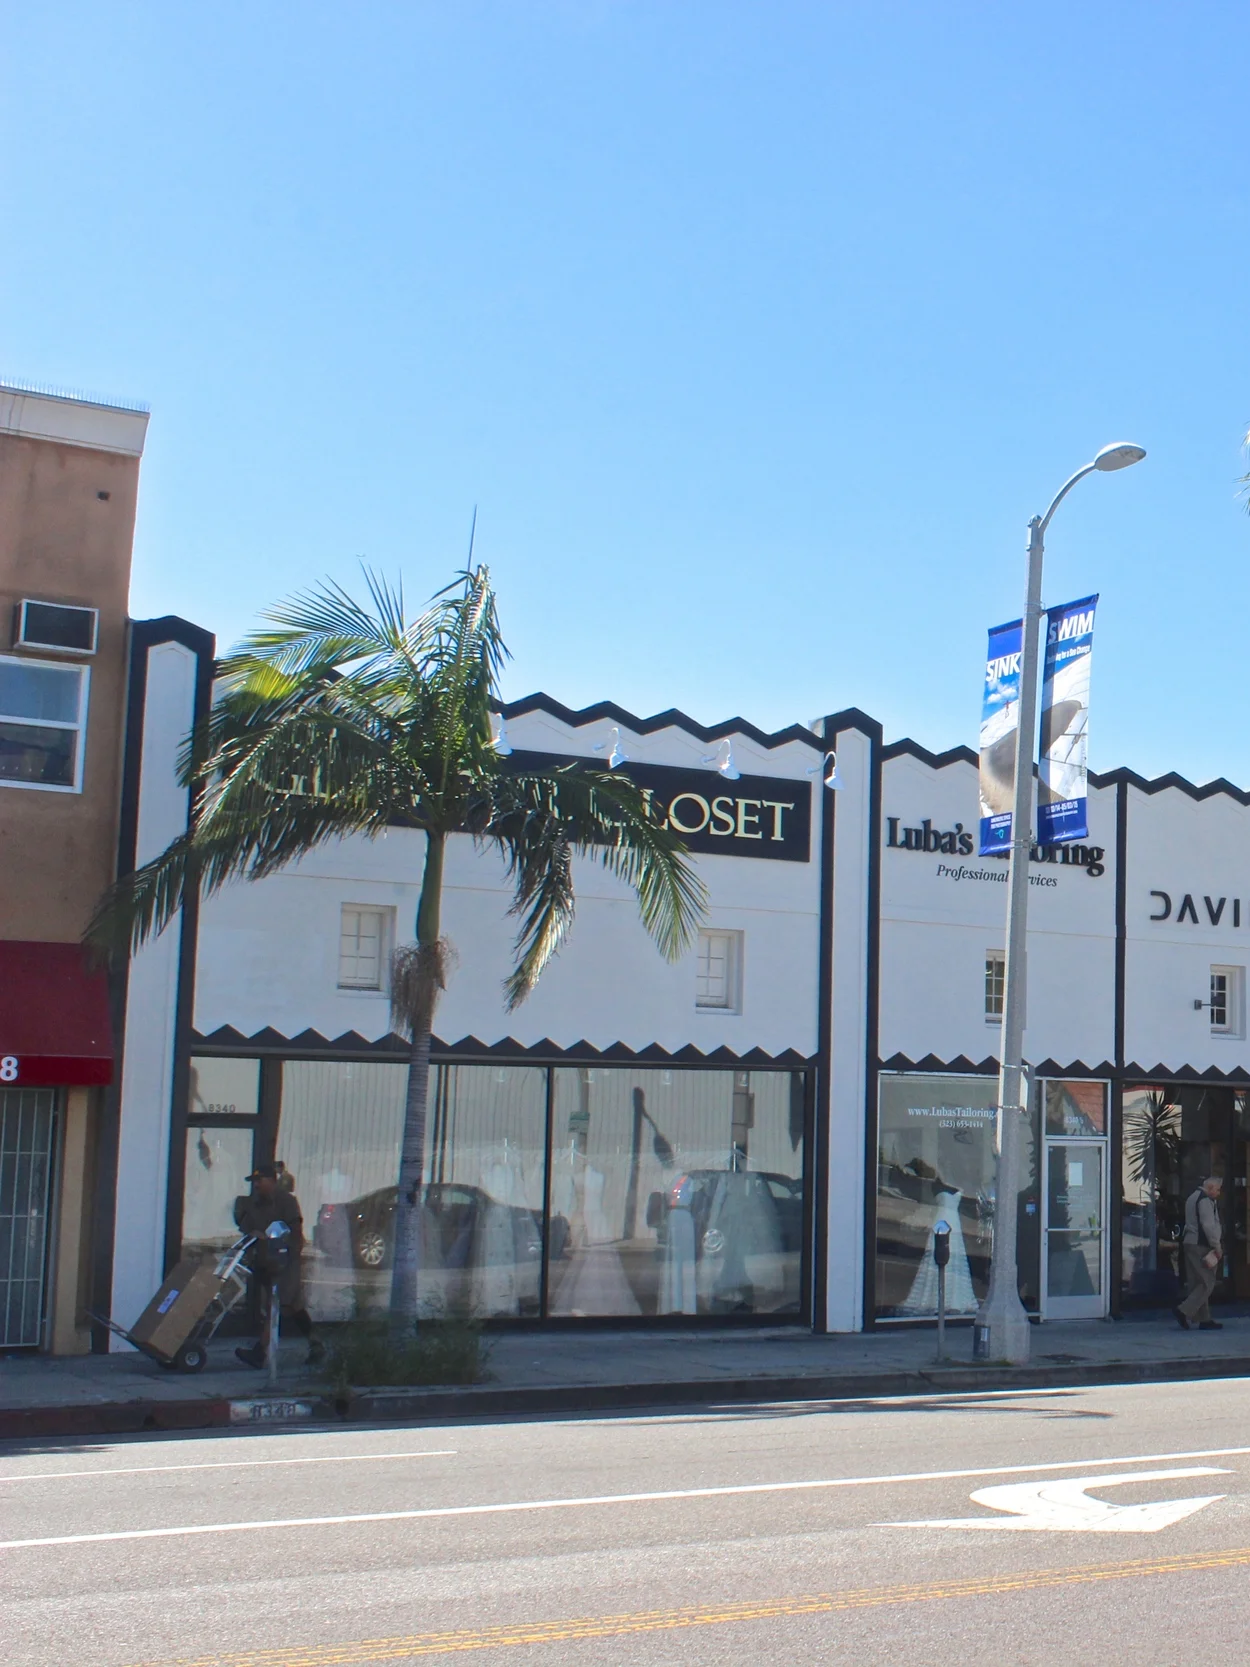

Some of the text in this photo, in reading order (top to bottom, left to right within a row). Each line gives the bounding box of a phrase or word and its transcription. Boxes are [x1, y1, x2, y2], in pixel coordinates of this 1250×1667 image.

[1048, 610, 1094, 645] SWIM
[985, 652, 1022, 682] SINK
[886, 816, 974, 855] Luba's
[936, 864, 1010, 883] Professional
[208, 1103, 236, 1114] 8340
